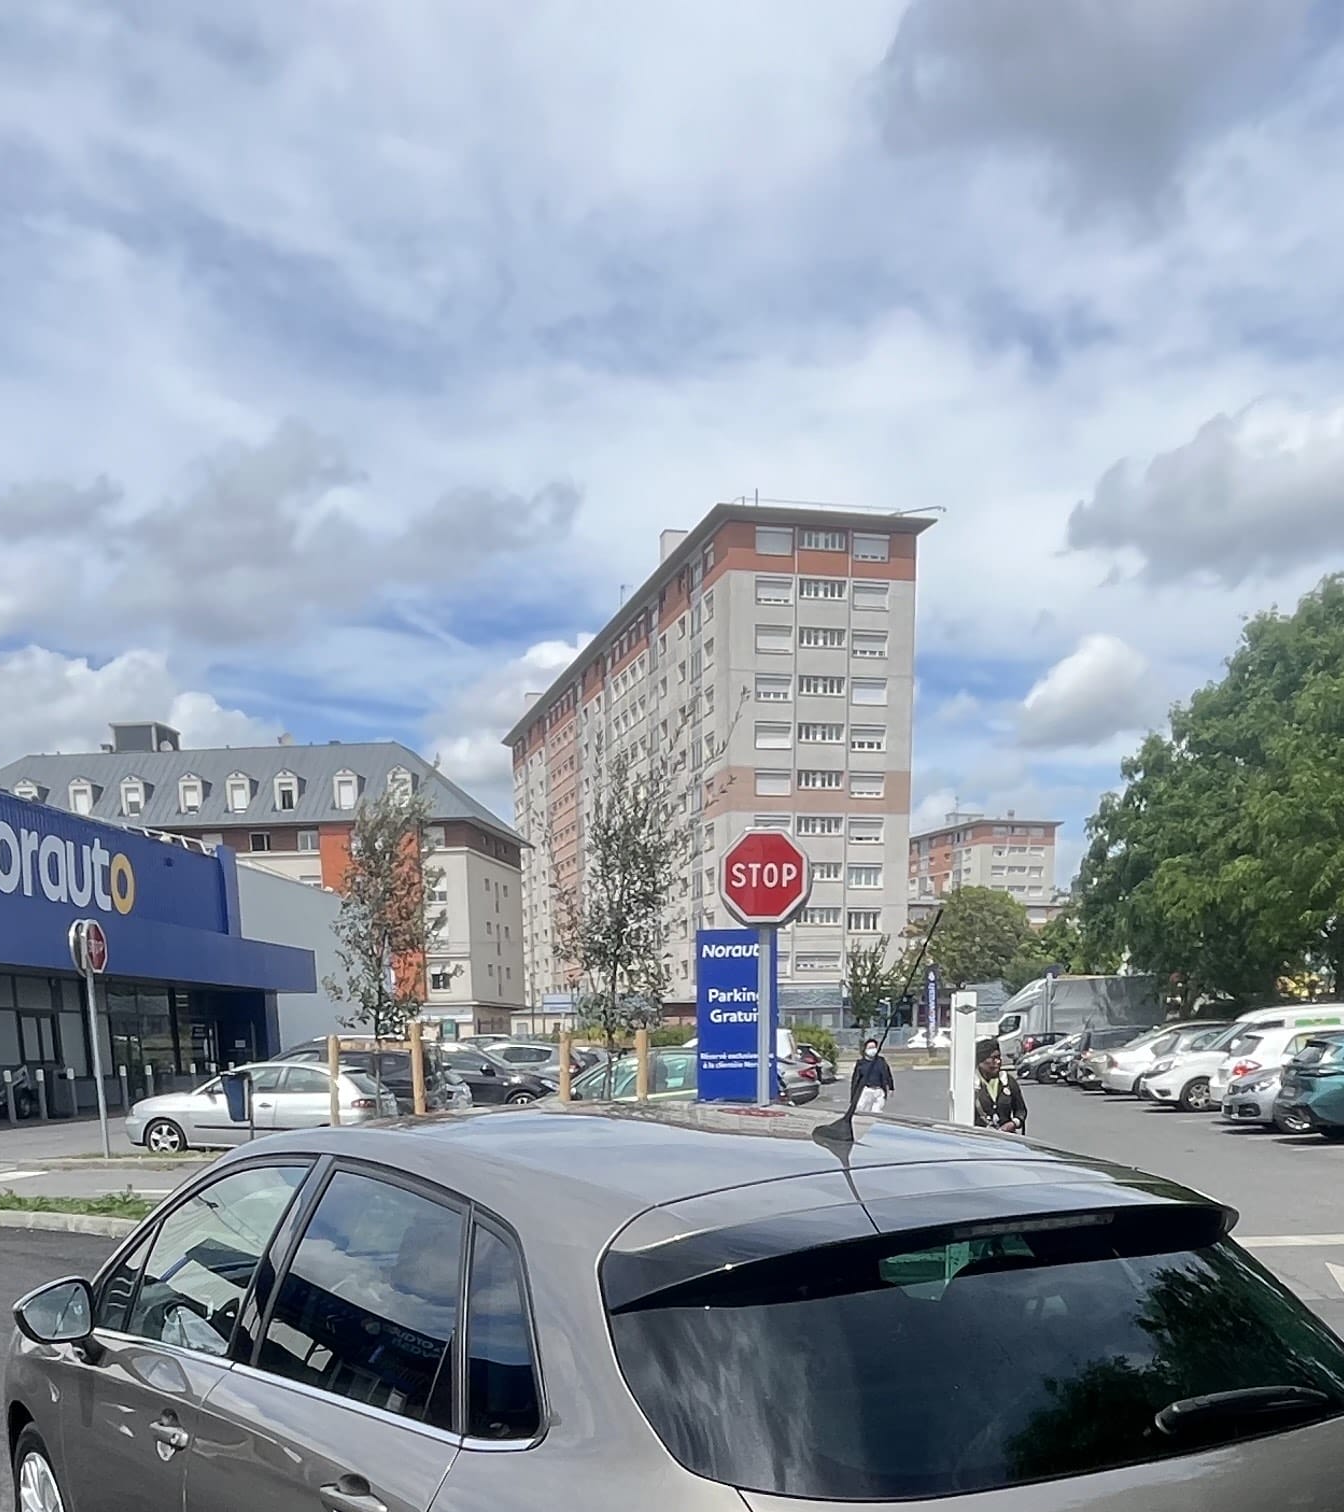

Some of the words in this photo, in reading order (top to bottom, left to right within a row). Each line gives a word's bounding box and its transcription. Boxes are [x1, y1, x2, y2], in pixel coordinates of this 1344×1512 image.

[731, 863, 797, 888] STOP
[702, 944, 760, 958] Noraut
[708, 987, 760, 1004] Parkin
[710, 1008, 760, 1023] Gratui
